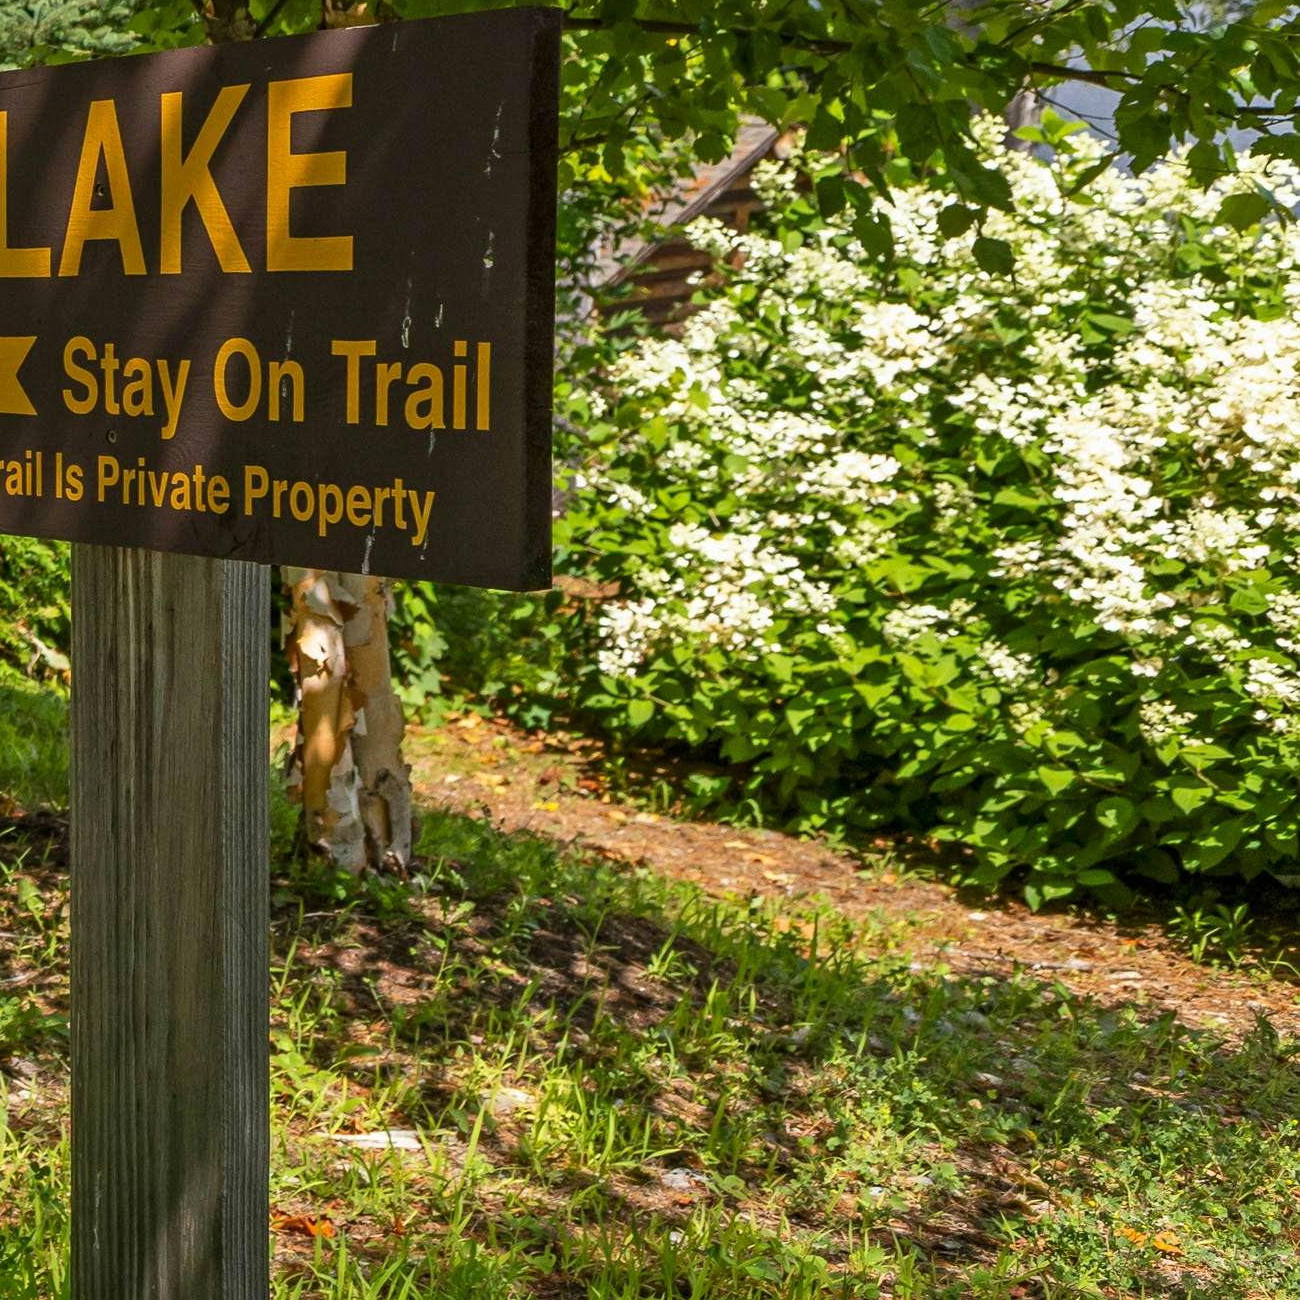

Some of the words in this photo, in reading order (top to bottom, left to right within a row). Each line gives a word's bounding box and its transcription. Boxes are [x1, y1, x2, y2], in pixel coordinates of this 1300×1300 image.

[62, 335, 192, 440] Stay
[212, 337, 305, 423] On
[331, 339, 491, 431] Trail
[56, 451, 84, 502] Is
[97, 455, 230, 514] Private
[244, 465, 436, 546] Property
